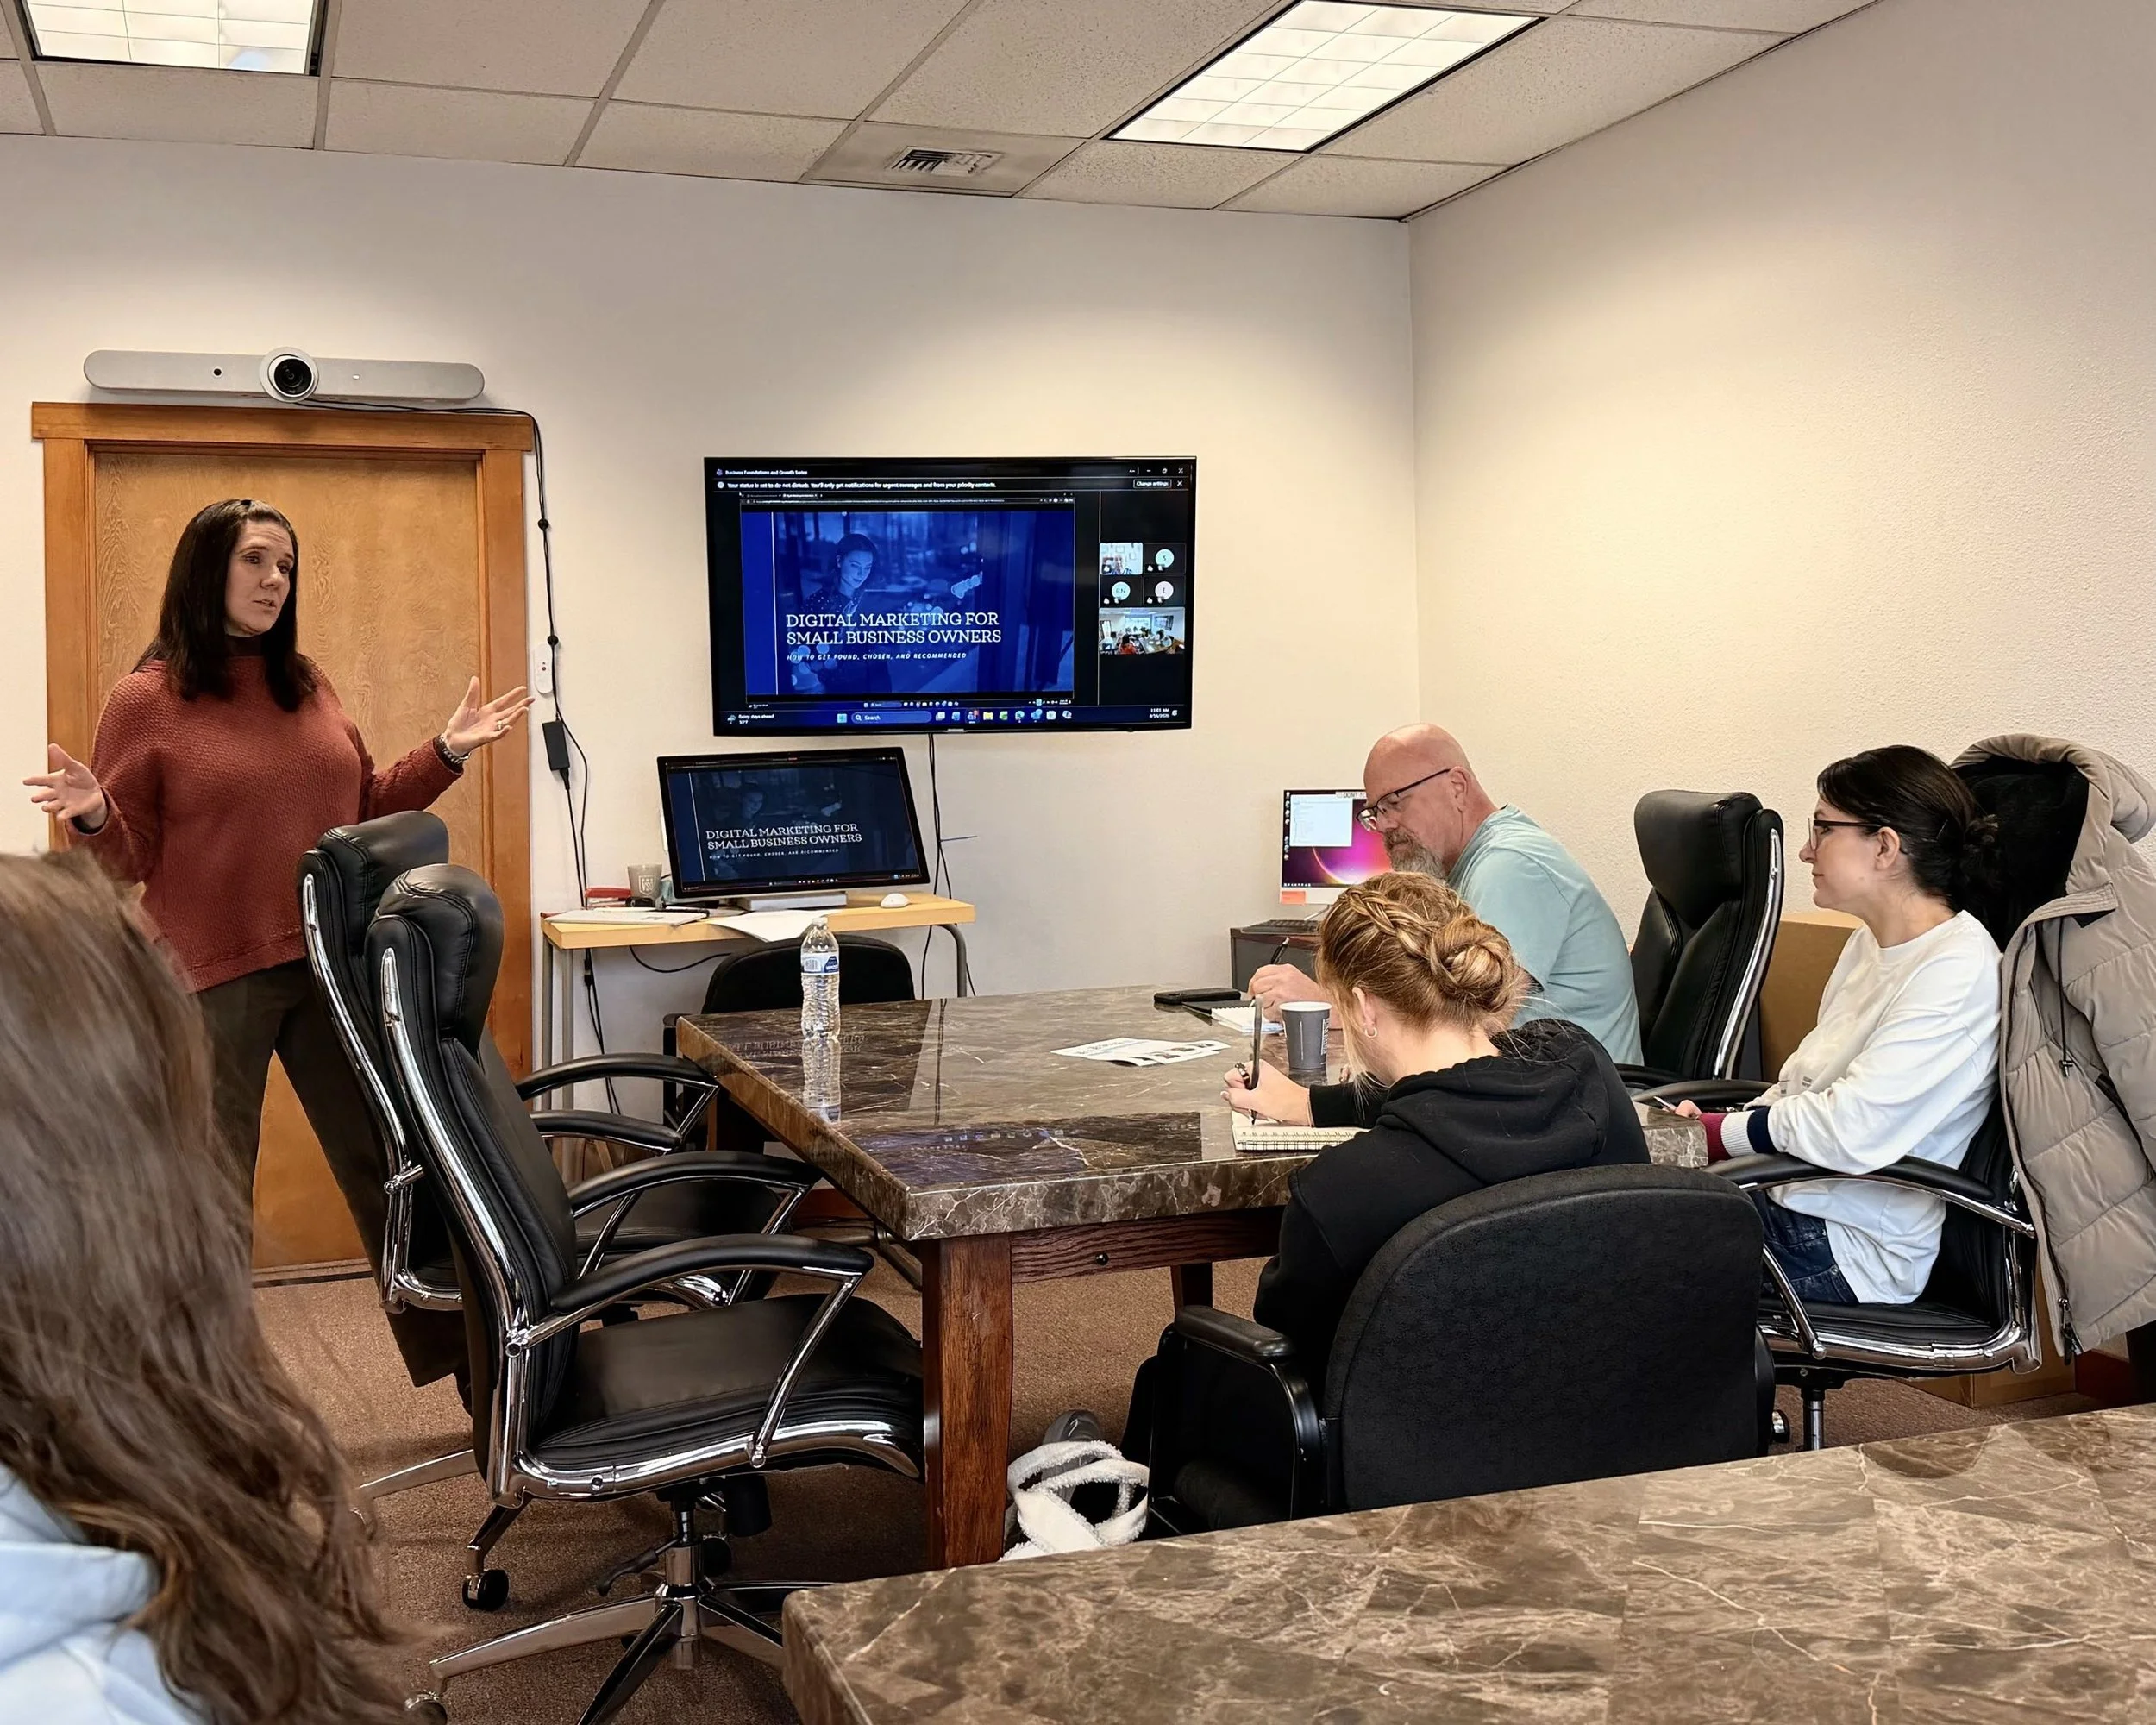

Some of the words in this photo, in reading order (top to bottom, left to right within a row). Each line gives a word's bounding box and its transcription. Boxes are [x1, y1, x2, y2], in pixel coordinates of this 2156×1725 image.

[786, 614, 857, 627] DIGITAL
[859, 612, 962, 627] MARKETING
[965, 612, 1000, 625] FOR
[787, 631, 843, 645] SMALL
[845, 630, 925, 644] BUSINESS
[928, 630, 1002, 643] OWNERS
[705, 828, 757, 840] DIGITAL
[758, 825, 832, 837] MARKETING
[834, 823, 859, 833] FOR
[707, 839, 749, 850] SMALL
[750, 837, 808, 849] BUSINESS
[809, 833, 862, 845] OWNERS
